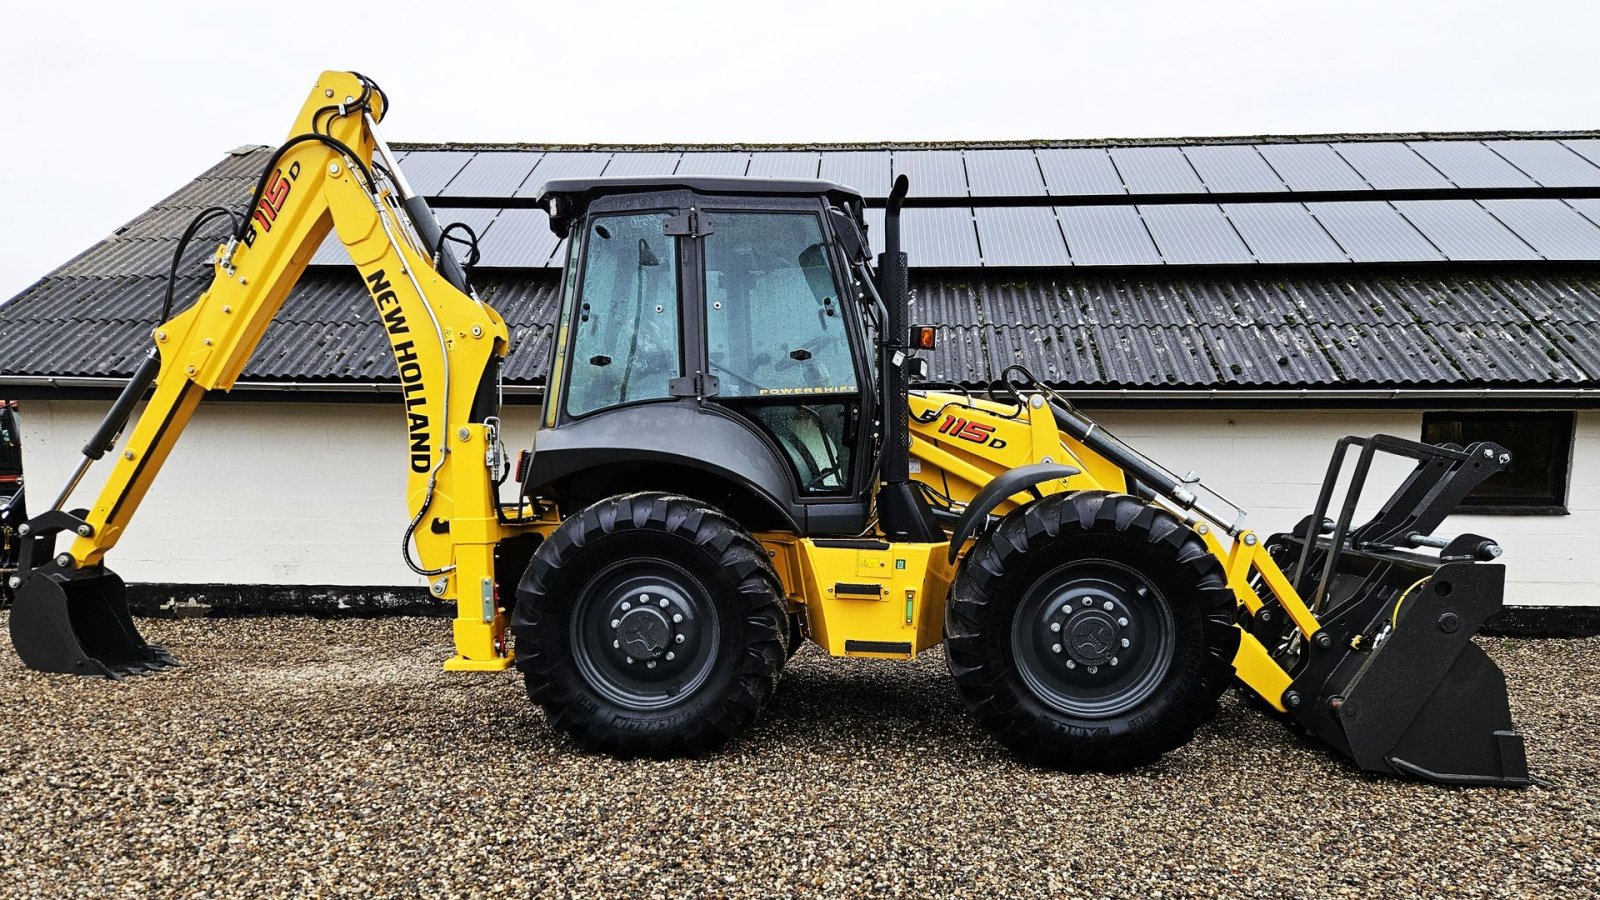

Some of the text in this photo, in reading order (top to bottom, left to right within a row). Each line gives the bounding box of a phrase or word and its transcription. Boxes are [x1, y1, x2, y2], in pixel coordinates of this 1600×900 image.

[366, 268, 410, 335] NEW
[392, 340, 432, 474] HOLLAND
[760, 385, 859, 395] POWERSHIFT
